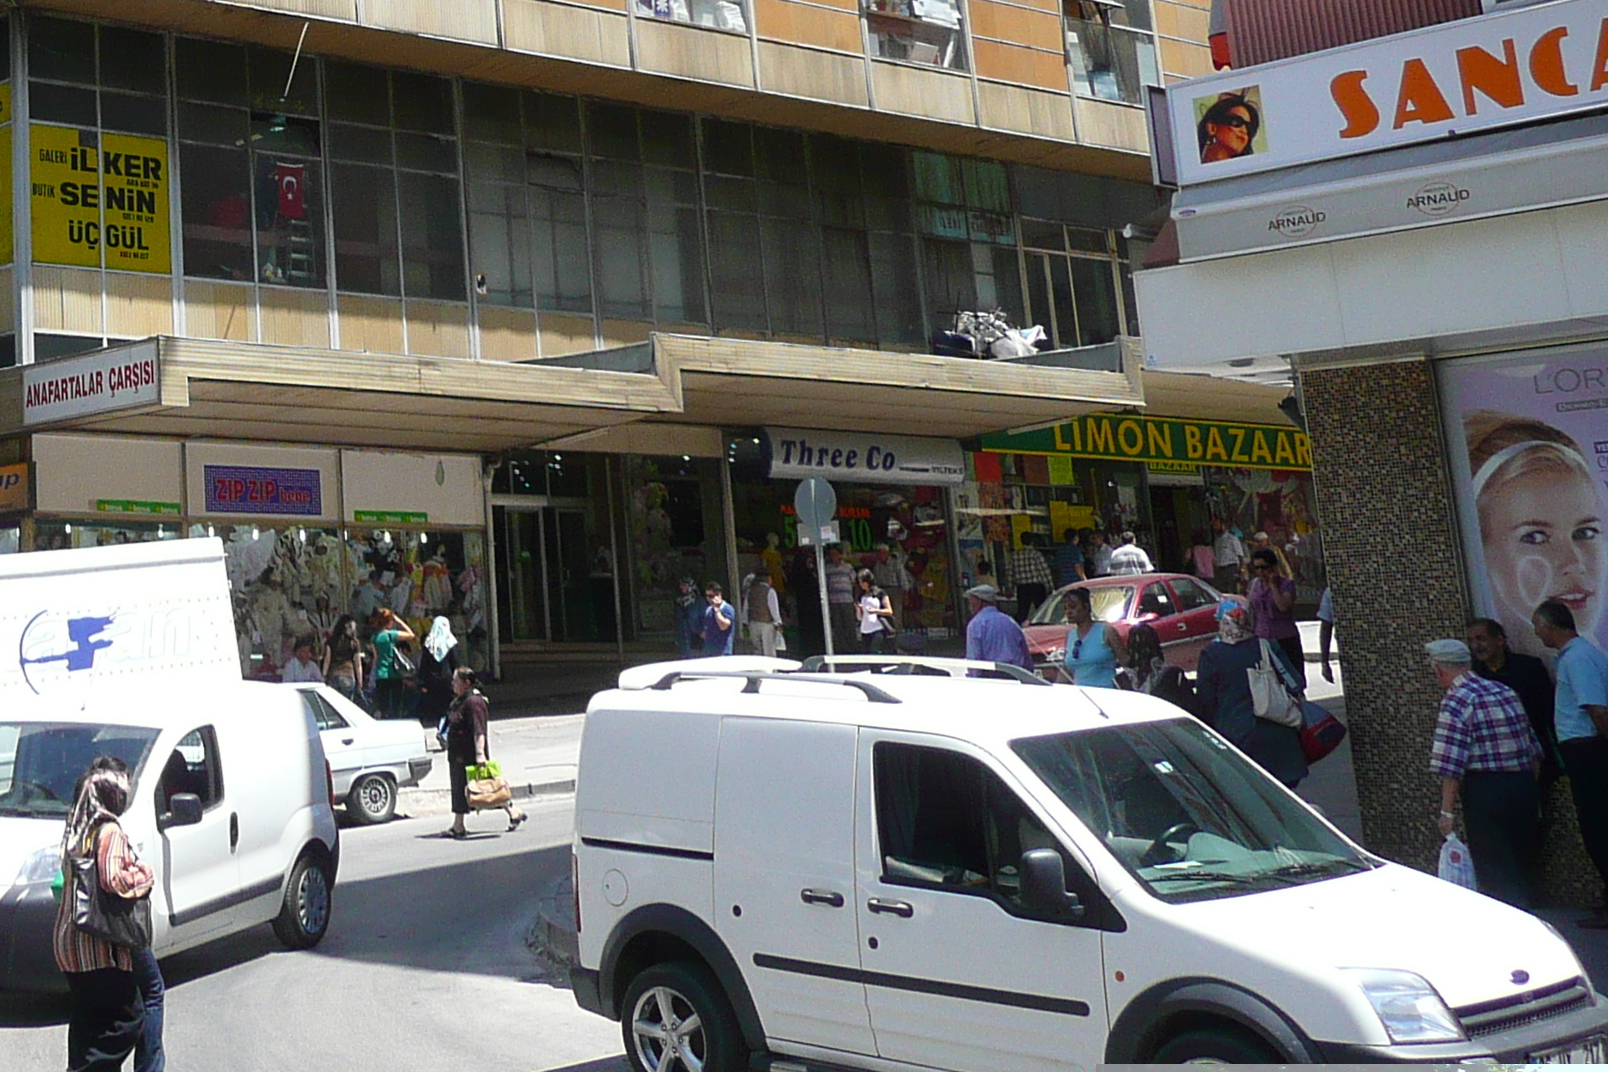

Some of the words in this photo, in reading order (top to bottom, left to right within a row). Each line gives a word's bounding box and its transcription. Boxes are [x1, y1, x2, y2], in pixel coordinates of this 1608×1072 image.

[70, 147, 162, 181] İLKER
[59, 182, 155, 214] SENİN
[1406, 188, 1470, 209] ARNAUD
[1268, 211, 1326, 231] ARNAUD
[26, 370, 104, 408] ANAFARTALAR
[108, 359, 155, 398] ÇARŞISI
[1533, 366, 1608, 394] L'OR
[781, 439, 858, 469] Three
[866, 445, 896, 471] Co
[1184, 424, 1312, 466] BAZAAR
